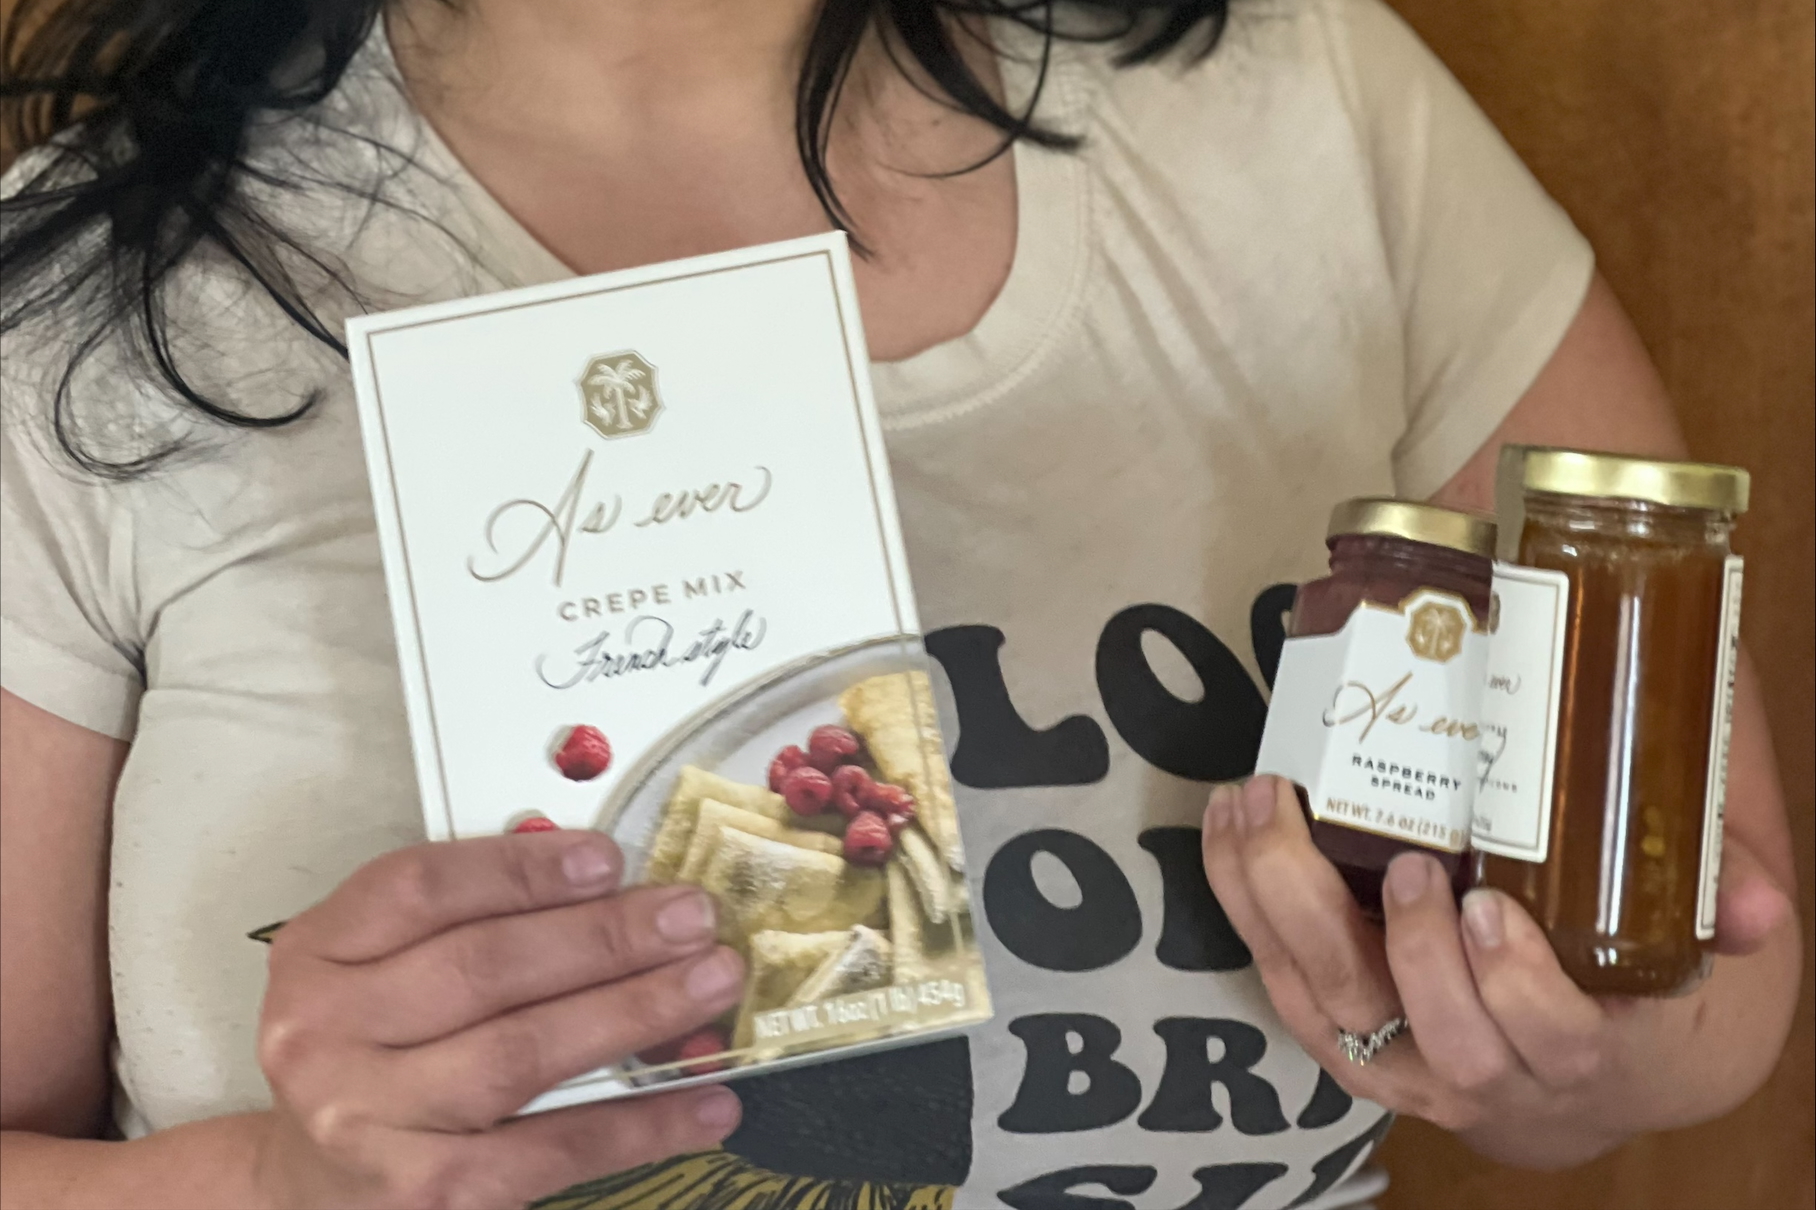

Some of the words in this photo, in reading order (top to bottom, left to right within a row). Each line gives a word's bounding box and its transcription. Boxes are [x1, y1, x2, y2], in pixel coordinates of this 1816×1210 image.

[467, 448, 623, 587] As
[634, 466, 772, 528] ever
[557, 584, 671, 622] CREPE
[682, 570, 747, 599] MIX
[535, 615, 675, 689] French
[678, 608, 767, 687] style
[1322, 670, 1418, 745] As
[1352, 753, 1462, 791] RASPBERRY
[1371, 776, 1436, 801] SPREAD
[1326, 797, 1348, 815] NET
[1351, 801, 1371, 821] WT.
[1375, 807, 1395, 827] 7.6
[754, 1011, 790, 1039] NET
